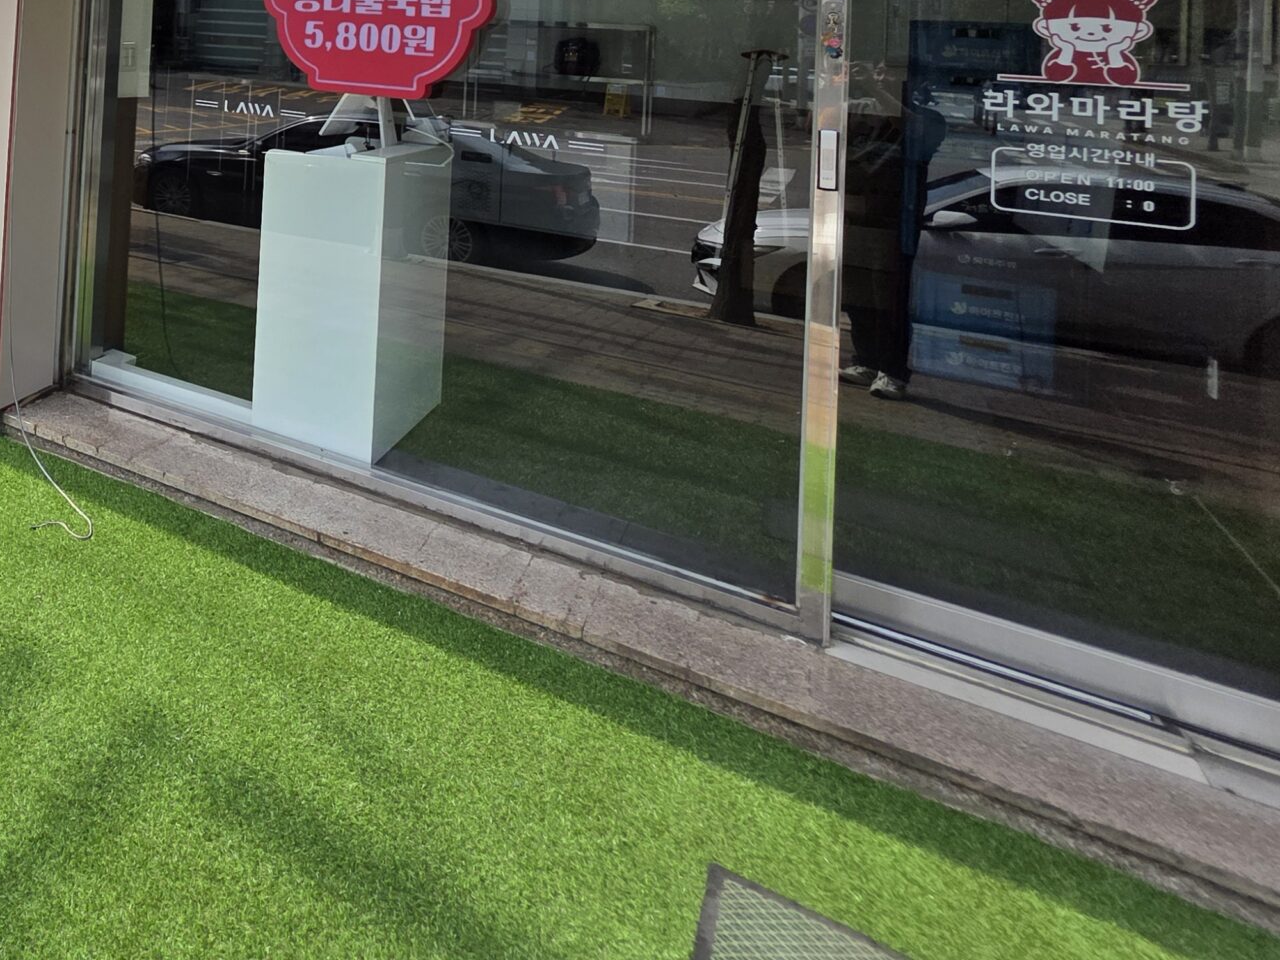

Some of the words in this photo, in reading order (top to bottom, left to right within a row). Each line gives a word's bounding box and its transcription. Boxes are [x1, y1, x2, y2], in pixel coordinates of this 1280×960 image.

[303, 20, 435, 57] 5,800원
[982, 89, 1209, 133] 라와마라탕
[997, 122, 1053, 135] LAWA
[1066, 127, 1190, 145] MARATANG
[1026, 142, 1155, 168] 영업시간안내
[1025, 169, 1091, 187] OPEN
[1106, 176, 1155, 193] 11:00
[1024, 188, 1091, 206] CLOSE
